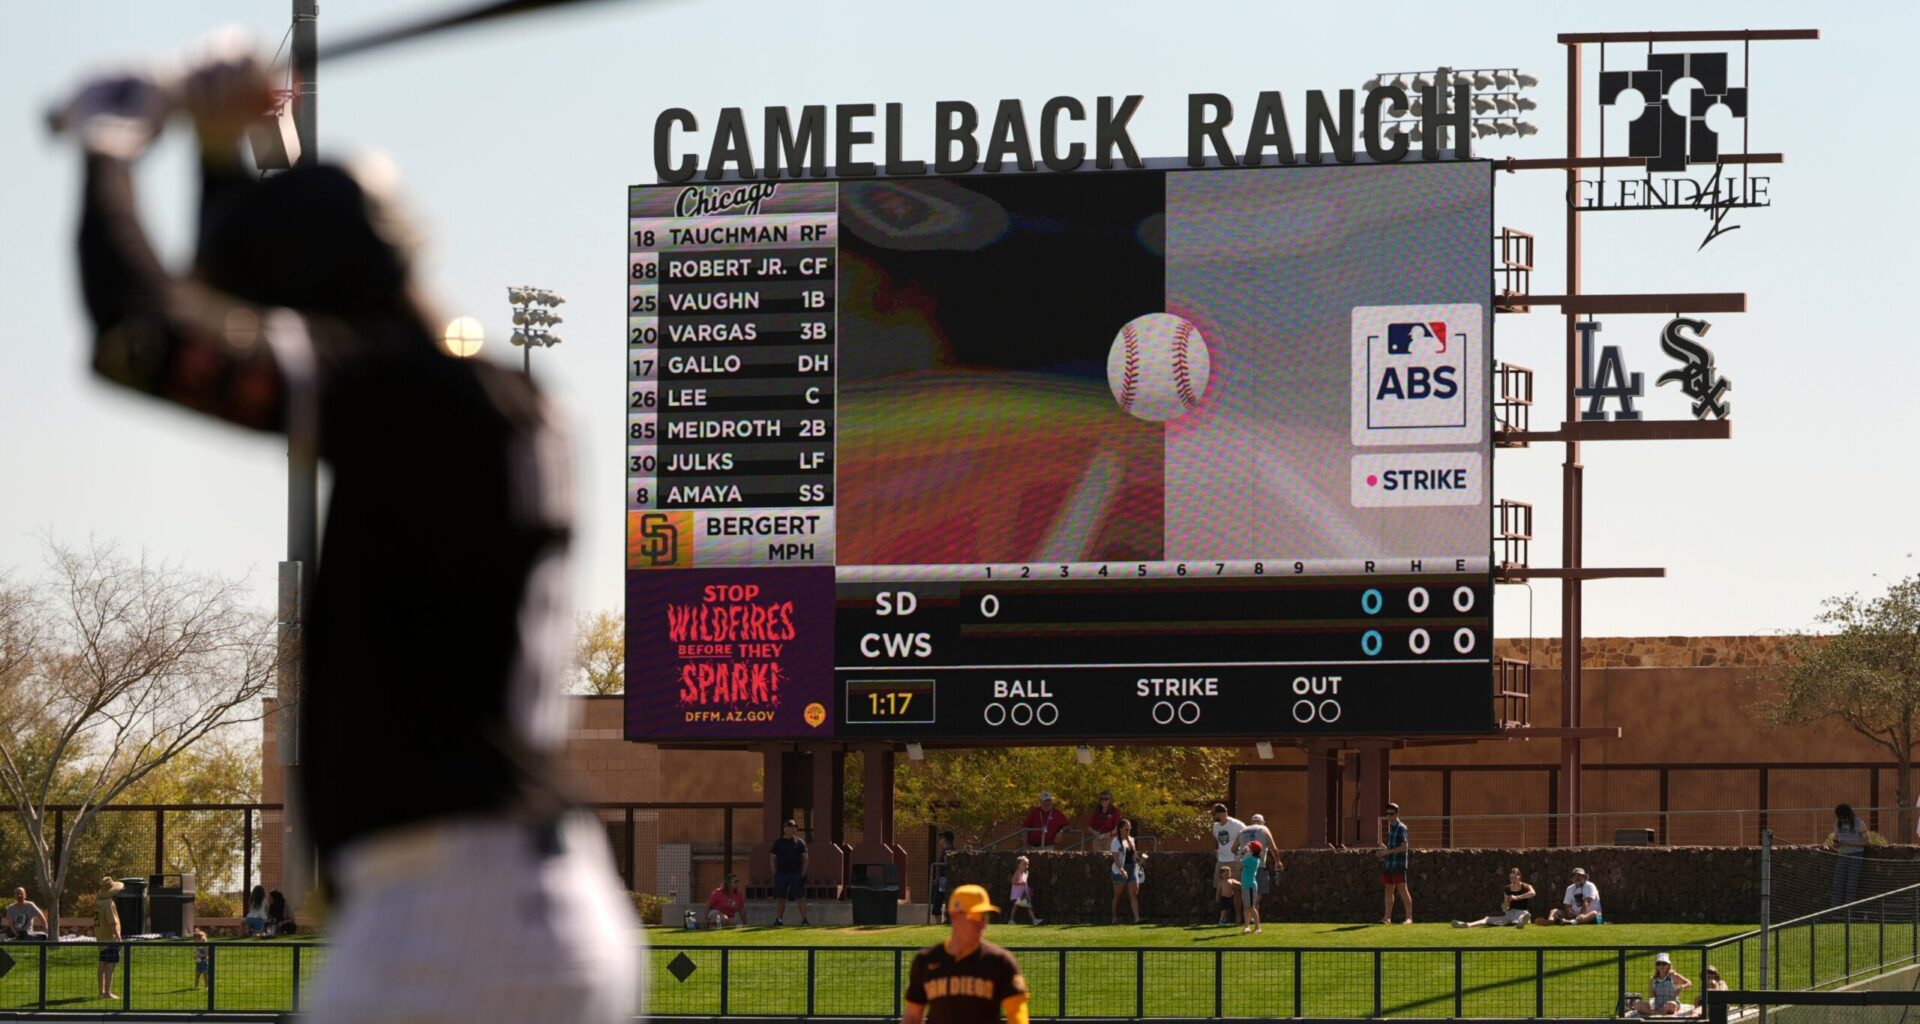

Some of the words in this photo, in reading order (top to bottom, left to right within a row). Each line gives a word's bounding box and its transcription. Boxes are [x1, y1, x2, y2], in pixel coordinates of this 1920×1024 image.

[653, 95, 1144, 183] CAMELBACK
[1188, 85, 1471, 166] RANCH
[675, 183, 781, 217] Chicago
[1566, 168, 1771, 213] GLENDALE
[634, 231, 655, 247] 18
[669, 226, 788, 245] TAUCHMAN
[800, 225, 828, 241] RF
[632, 263, 657, 279] 88
[669, 259, 752, 278] ROBERT
[757, 258, 787, 275] JR.
[799, 258, 828, 275] CF
[631, 296, 657, 312] 25
[668, 291, 760, 310] VAUGHN
[801, 290, 825, 308] 1B
[631, 328, 657, 344] 20
[668, 323, 757, 342] VARGAS
[800, 322, 827, 340] 3B
[633, 360, 654, 376] 17
[668, 355, 741, 373] GALLO
[798, 354, 829, 372] DH
[1574, 322, 1644, 421] LA
[1376, 365, 1458, 400] ABS
[631, 391, 656, 408] 26
[668, 389, 707, 406] LEE
[805, 387, 820, 404] C
[630, 423, 656, 439] 85
[667, 419, 781, 438] MEIDROTH
[799, 419, 826, 437] 2B
[630, 456, 656, 472] 30
[667, 453, 734, 471] JULKS
[799, 452, 825, 469] LF
[1383, 469, 1467, 491] STRIKE
[636, 488, 649, 504] 8
[666, 485, 743, 503] AMAYA
[799, 484, 825, 502] SS
[706, 516, 820, 536] BERGERT
[640, 513, 678, 566] SD
[768, 543, 814, 560] MPH
[985, 567, 992, 578] 1
[1020, 566, 1030, 578] 2
[1060, 566, 1069, 578] 3
[1098, 565, 1108, 577] 4
[1138, 565, 1147, 577] 5
[1177, 564, 1187, 576] 6
[1215, 563, 1225, 576] 7
[1254, 563, 1264, 576] 8
[1294, 562, 1304, 575] 9
[1365, 561, 1376, 573] R
[1411, 560, 1422, 573] H
[1456, 559, 1465, 572] E
[703, 585, 760, 602] STOP
[875, 591, 918, 616] SD
[980, 594, 1000, 618] 0
[1361, 588, 1383, 615] 0
[1408, 586, 1430, 613] 0
[1452, 586, 1475, 613] 0
[667, 601, 796, 642] WILDFIRES
[678, 644, 732, 655] BEFORE
[739, 643, 783, 658] THEY
[860, 632, 932, 658] CWS
[1361, 629, 1383, 656] 0
[1408, 627, 1431, 654] 0
[1453, 627, 1476, 654] 0
[680, 662, 781, 705] SPARK!
[994, 680, 1053, 698] BALL
[1136, 677, 1218, 697] STRIKE
[1292, 676, 1342, 695] OUT
[868, 693, 913, 716] 1:17
[685, 711, 775, 722] DFFM.AZ.GOV
[949, 975, 994, 1001] DIEGO
